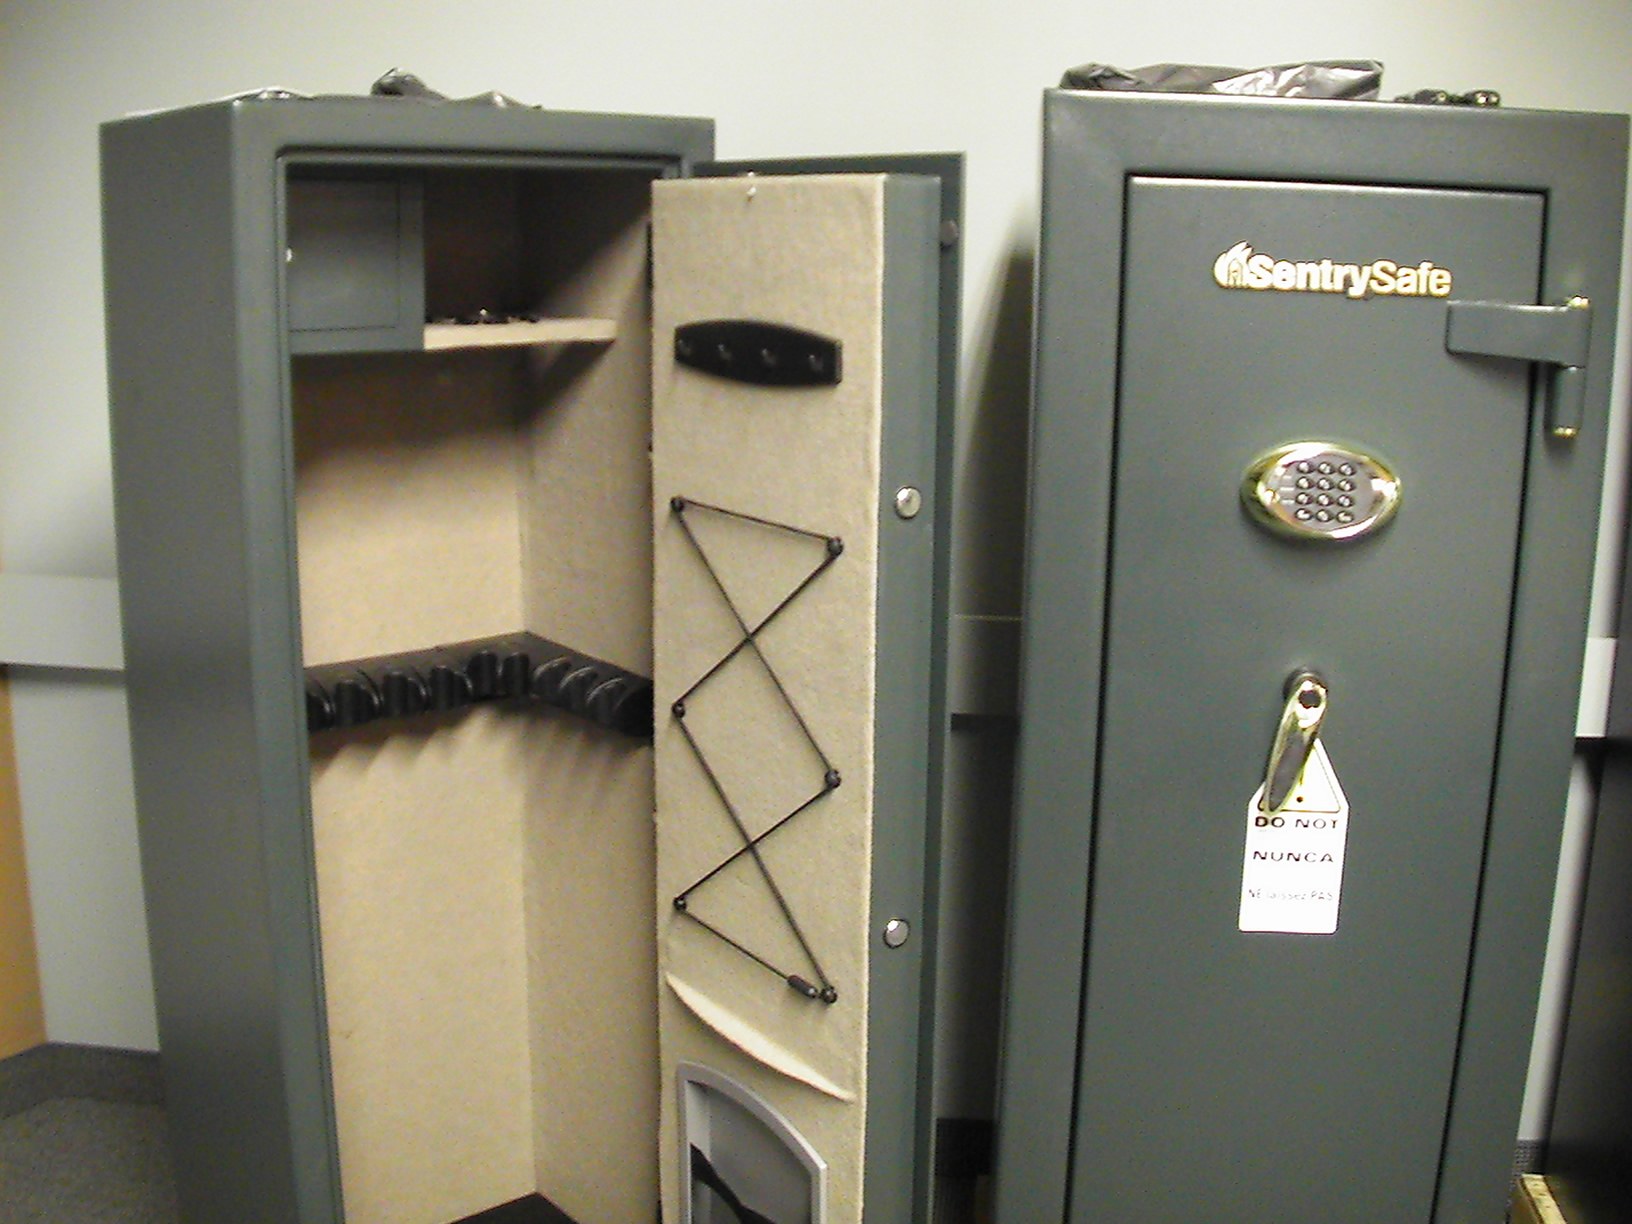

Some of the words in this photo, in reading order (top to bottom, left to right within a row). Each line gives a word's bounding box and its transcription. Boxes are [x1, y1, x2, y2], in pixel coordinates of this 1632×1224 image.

[1247, 253, 1452, 299] SentrySafe
[1254, 816, 1286, 828] DO
[1295, 818, 1338, 830] NOT
[1252, 850, 1334, 863] NUNCA
